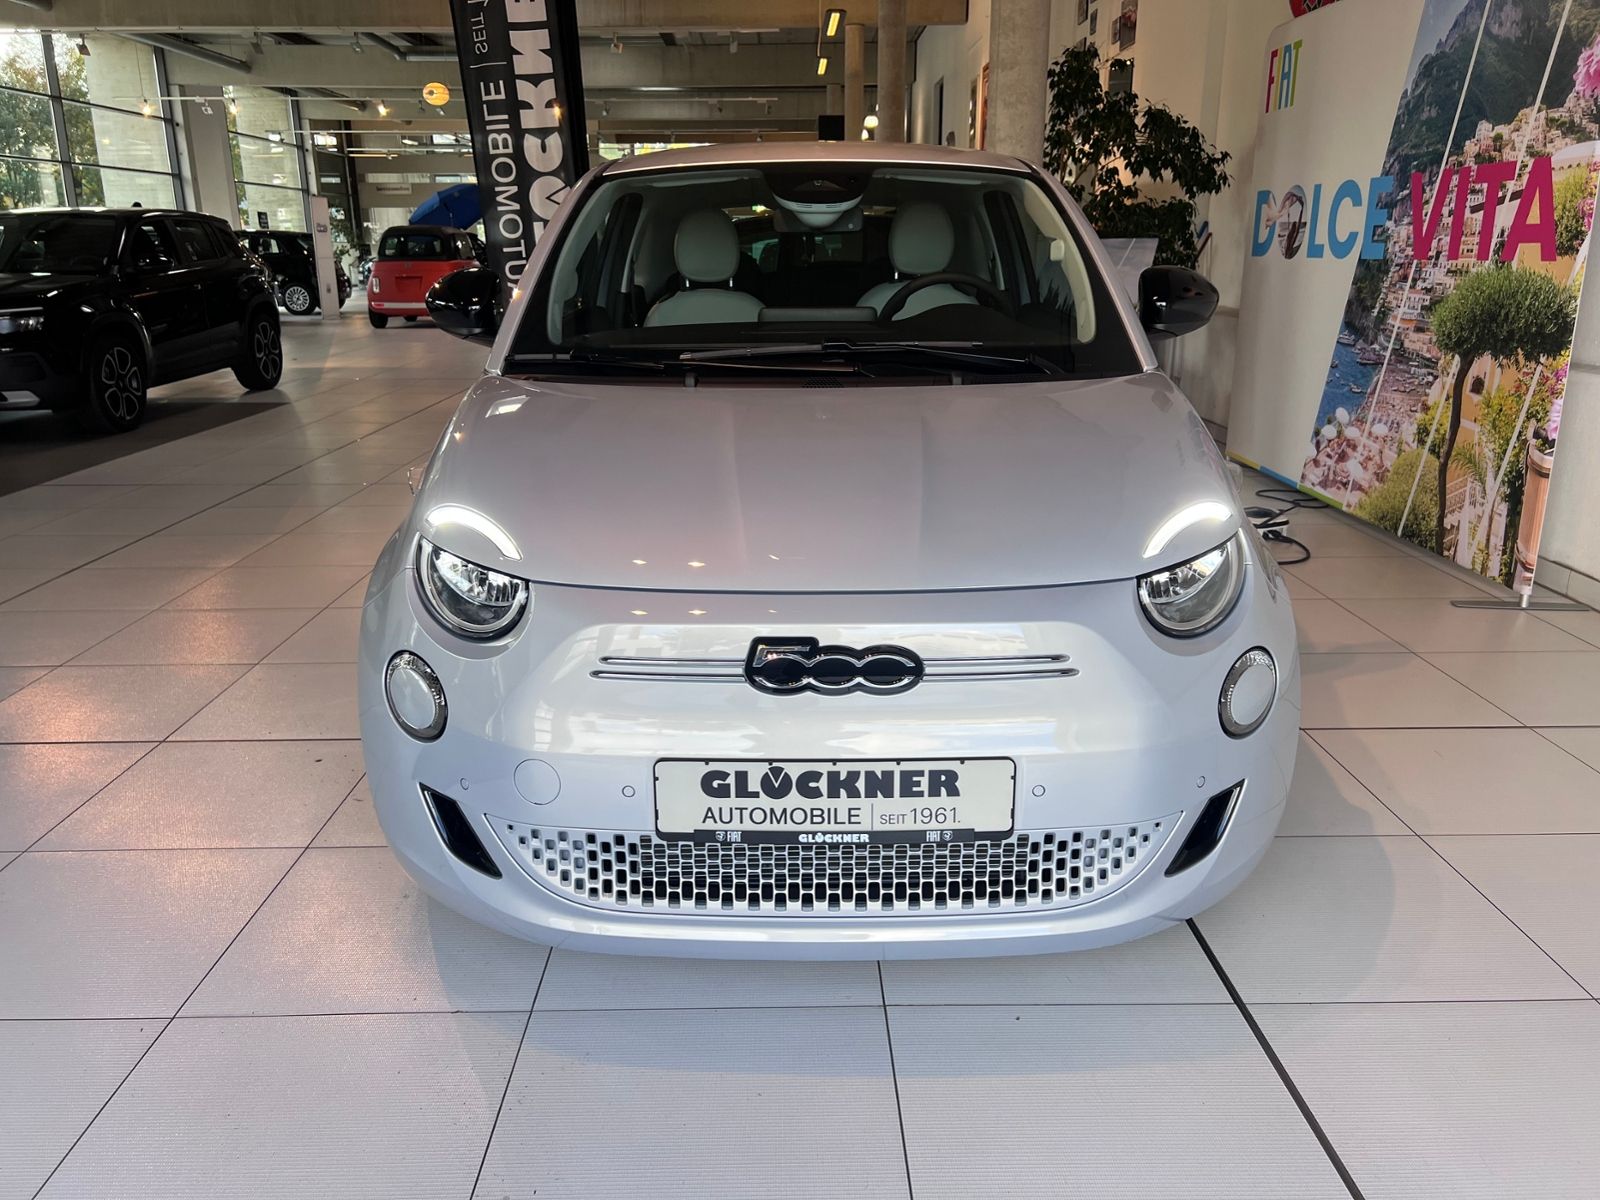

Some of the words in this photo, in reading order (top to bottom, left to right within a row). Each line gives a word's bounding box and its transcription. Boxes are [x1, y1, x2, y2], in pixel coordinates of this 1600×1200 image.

[1265, 39, 1303, 114] FIAT
[1251, 175, 1394, 260] DOLCE
[1411, 156, 1557, 262] VITA
[745, 637, 924, 696] 500
[702, 807, 861, 825] AUTOMOBILE
[879, 814, 907, 825] SEIT
[910, 807, 961, 825] 1961.
[727, 831, 742, 842] FIAT
[926, 831, 941, 842] FIAT
